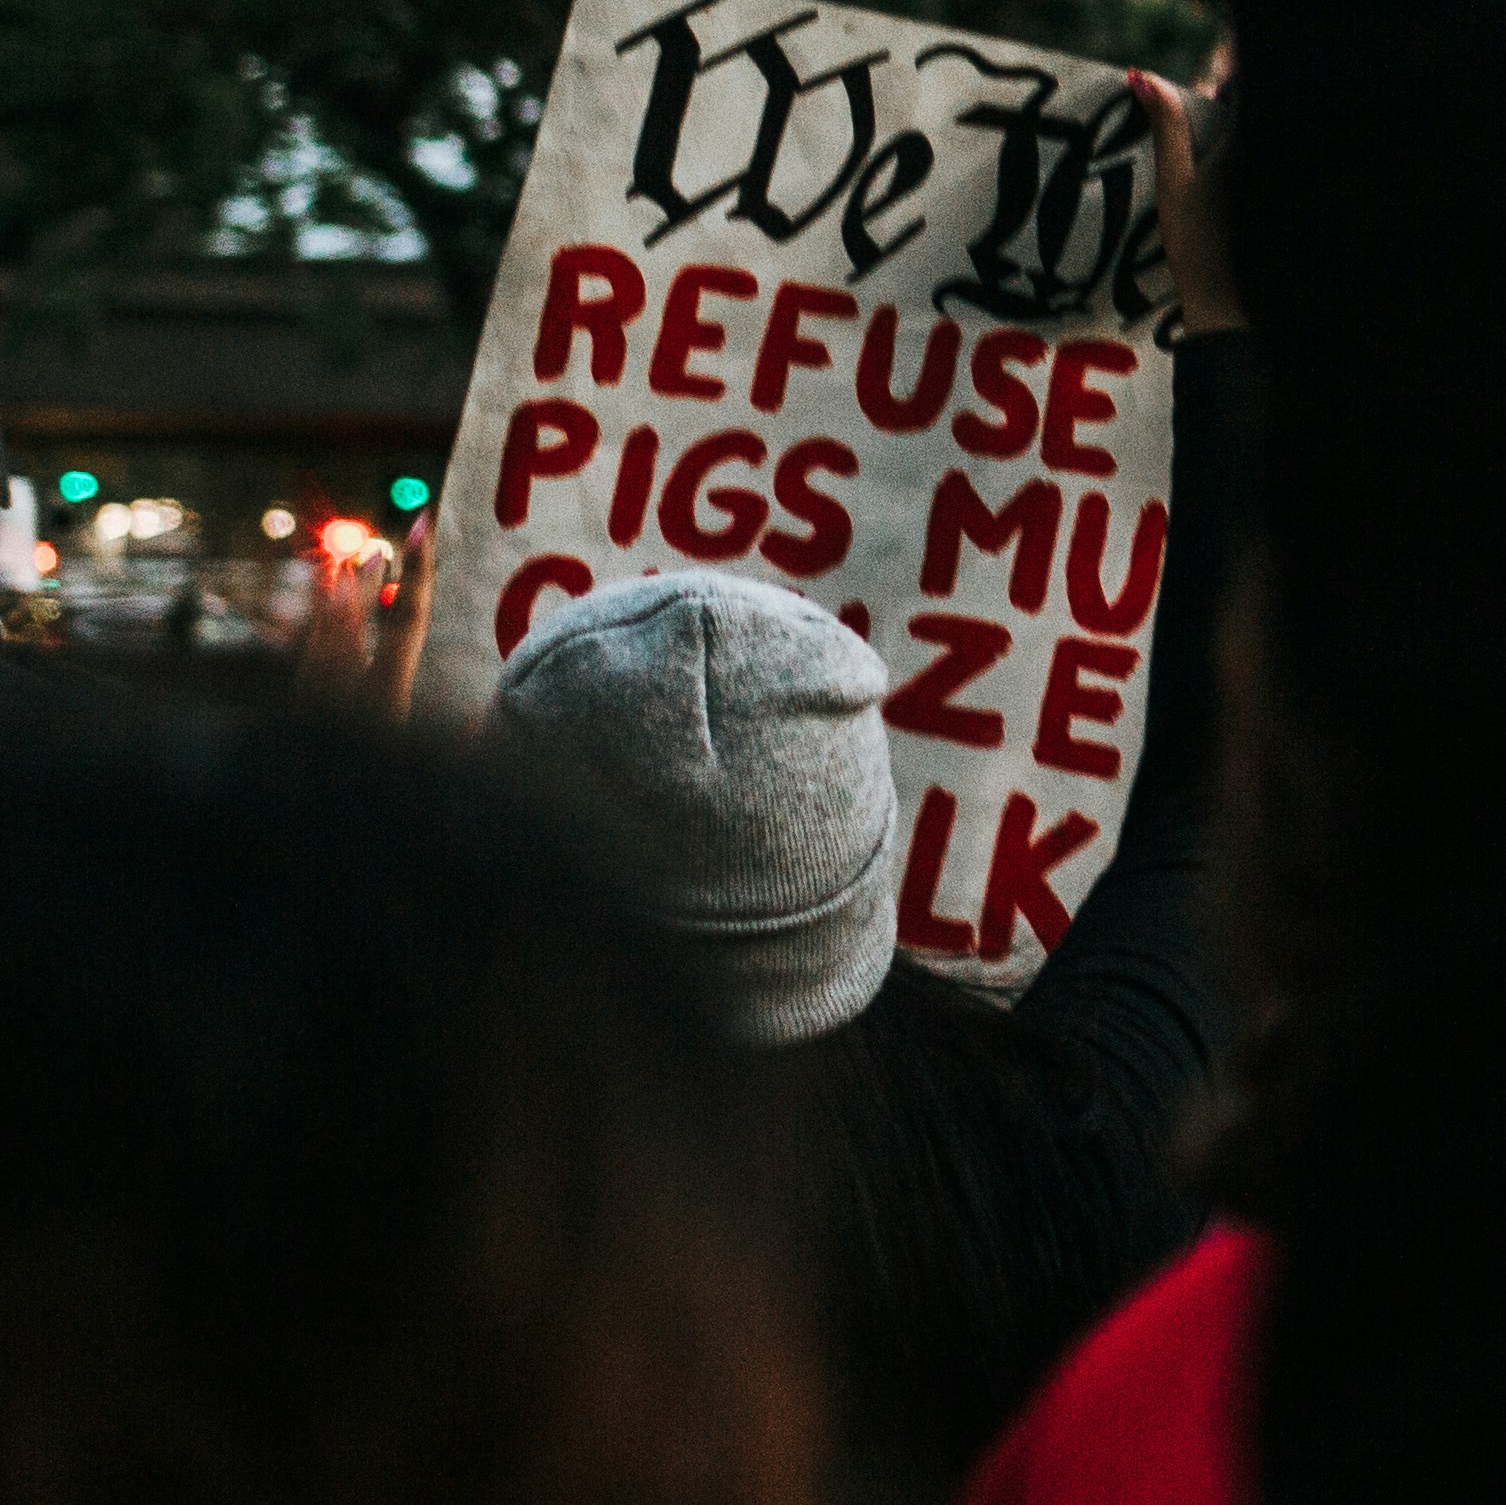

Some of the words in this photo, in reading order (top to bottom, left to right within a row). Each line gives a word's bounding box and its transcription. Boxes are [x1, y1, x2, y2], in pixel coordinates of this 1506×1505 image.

[532, 243, 1141, 479] REFUSE
[493, 397, 861, 579] PIGS
[917, 468, 1169, 636] MU
